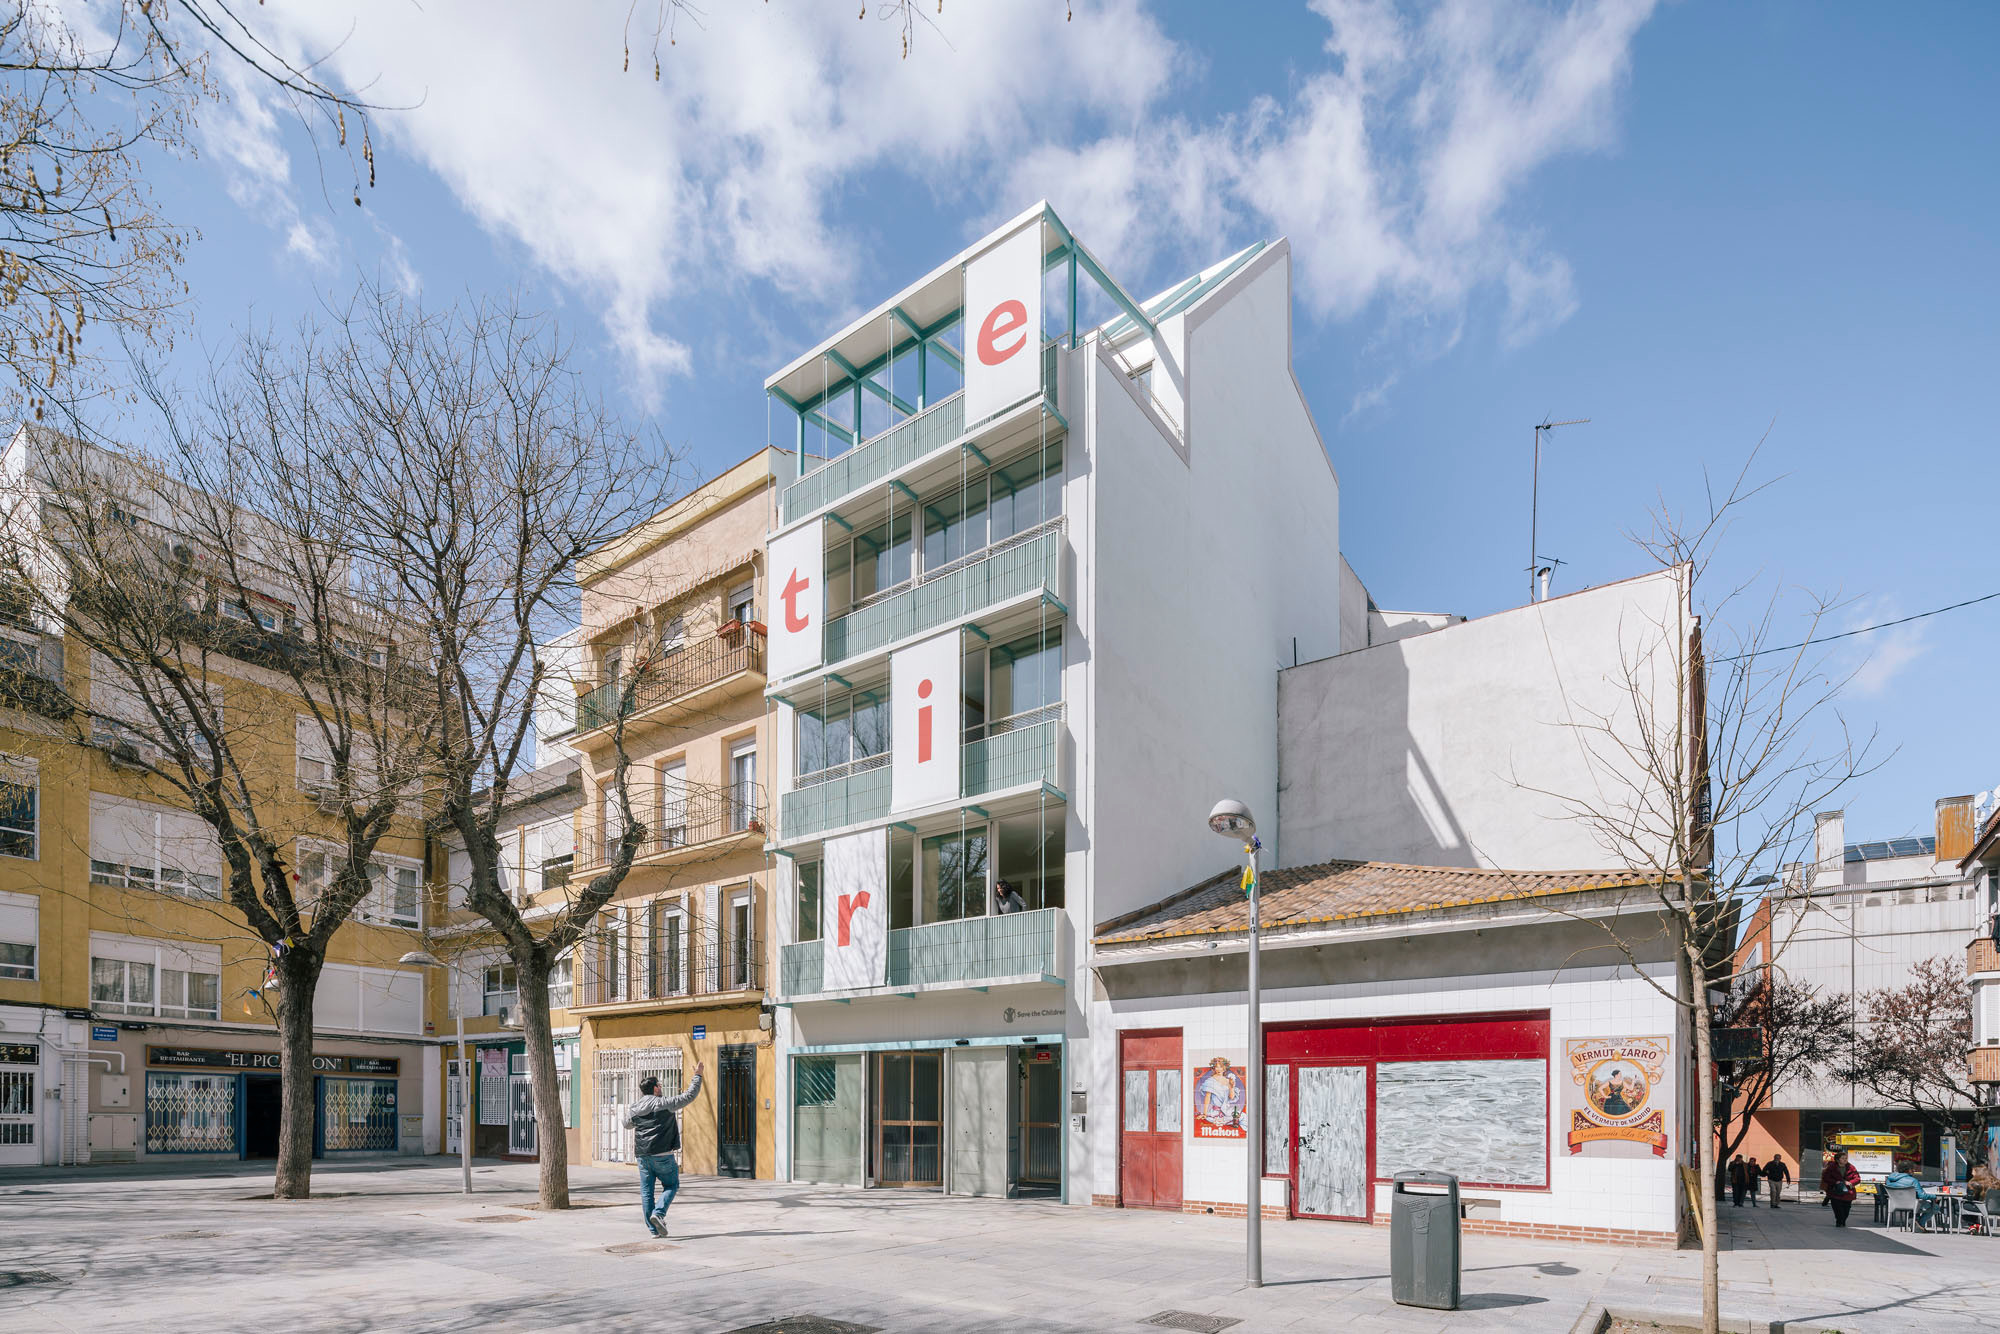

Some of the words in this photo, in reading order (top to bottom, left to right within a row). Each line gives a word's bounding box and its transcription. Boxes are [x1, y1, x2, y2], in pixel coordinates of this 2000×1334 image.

[976, 299, 1028, 367] e
[780, 566, 810, 634] t
[917, 678, 933, 764] i
[837, 890, 871, 947] r
[160, 1055, 206, 1063] RESTAURANTE
[1575, 1048, 1615, 1062] VERMUT
[1620, 1048, 1657, 1060] ZARRO
[1201, 1126, 1240, 1137] Mahou
[1583, 1106, 1592, 1115] EL
[1591, 1113, 1620, 1127] VERMUT
[1628, 1106, 1651, 1124] MADRID
